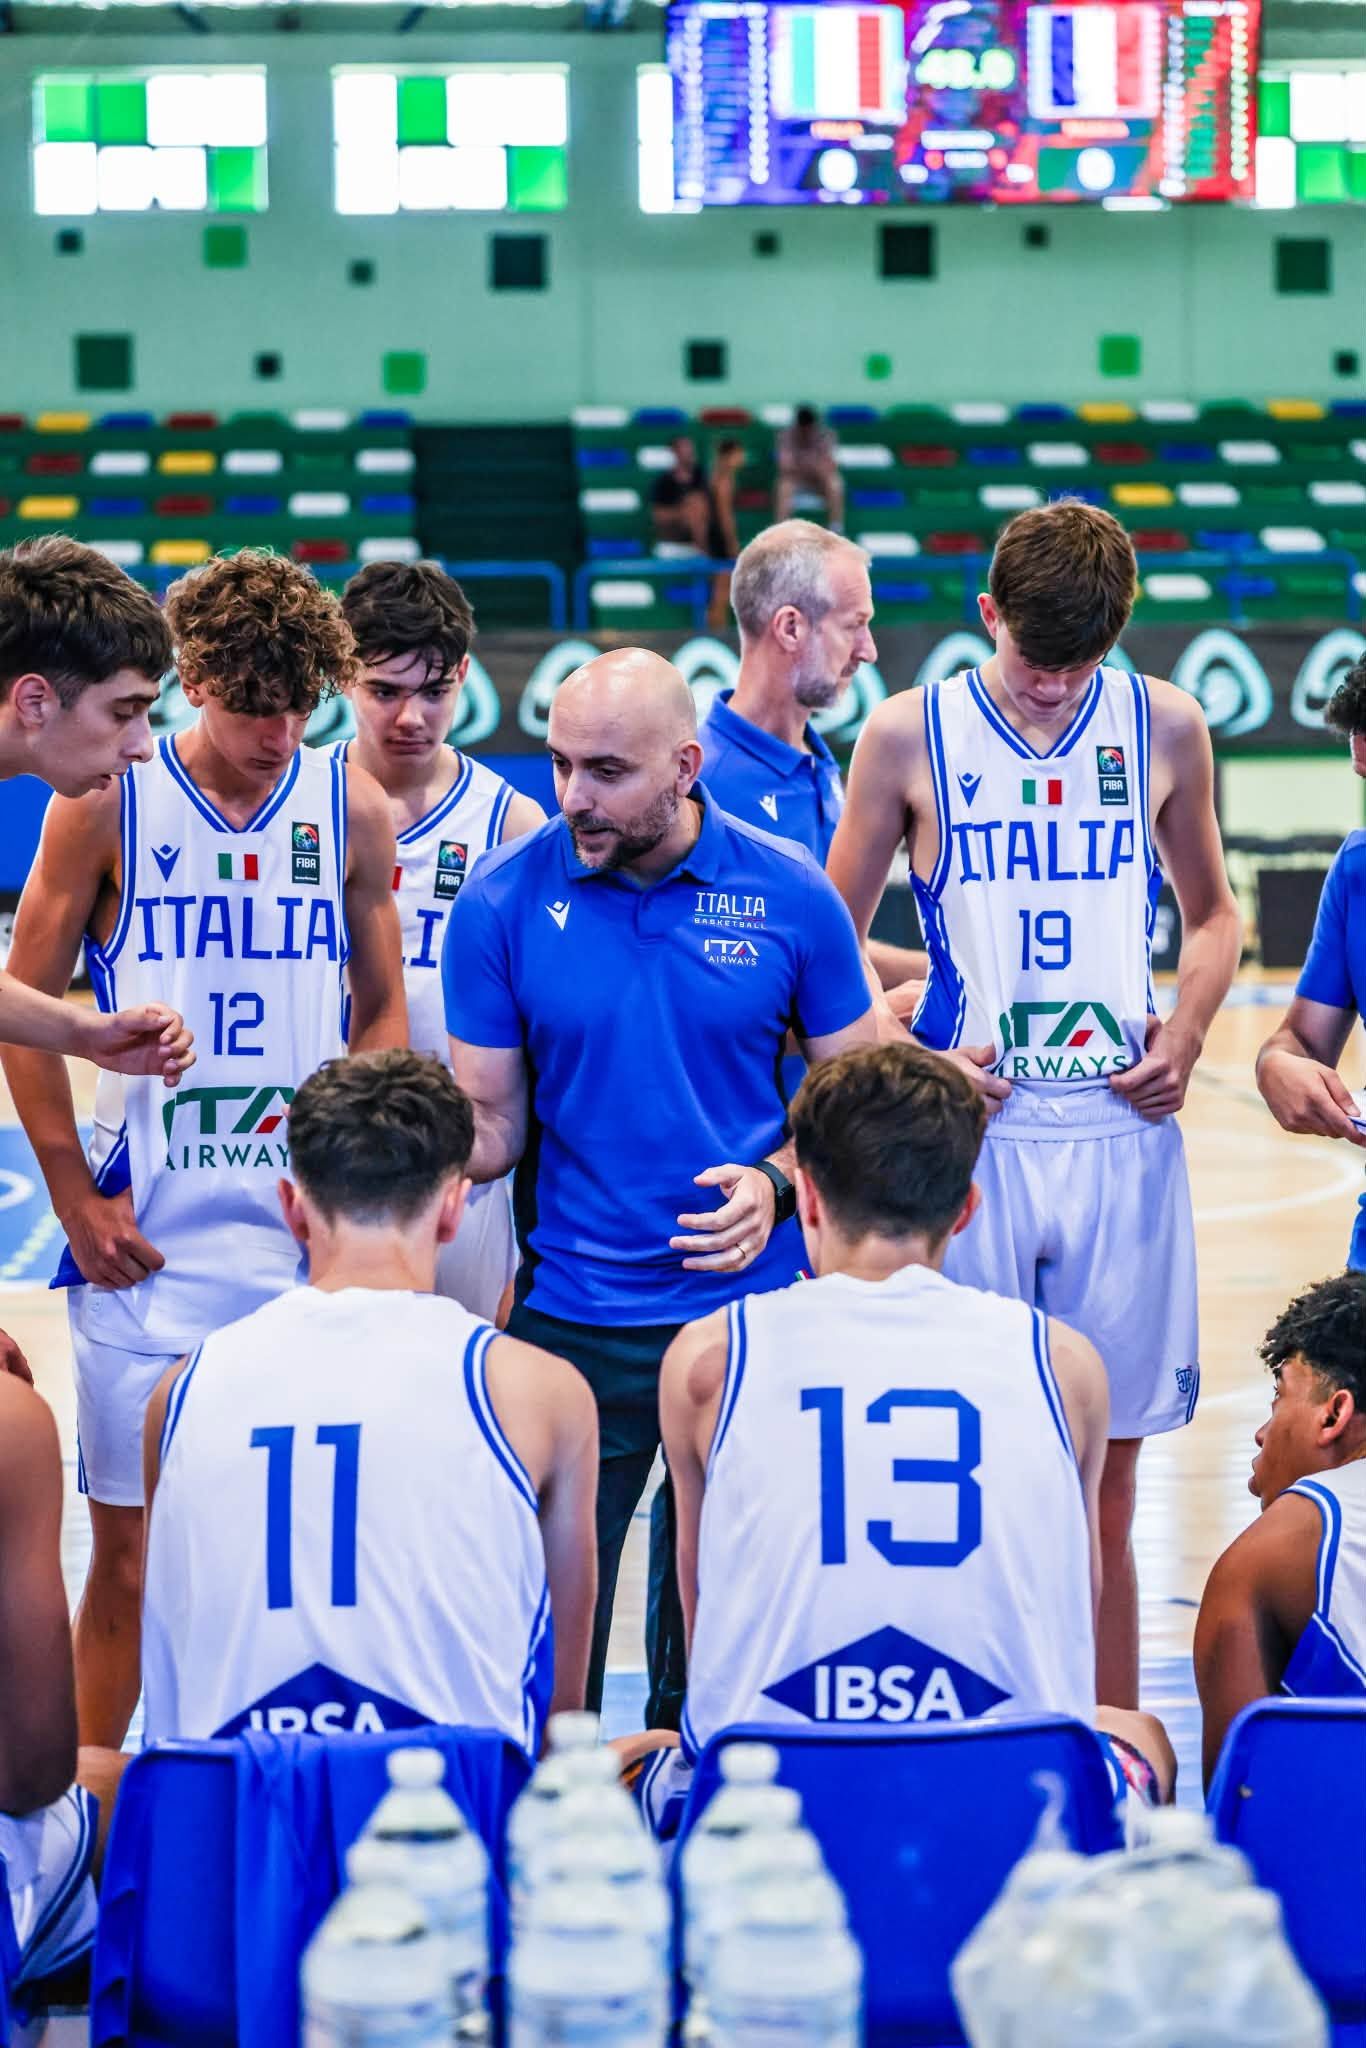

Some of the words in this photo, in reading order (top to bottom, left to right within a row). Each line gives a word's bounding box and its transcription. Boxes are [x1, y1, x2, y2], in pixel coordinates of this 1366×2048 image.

[1103, 779, 1123, 791] FIBA
[296, 857, 316, 869] FIBA
[439, 874, 461, 887] FIBA
[694, 892, 766, 917] ITALIA
[135, 895, 338, 962] ITALIA
[694, 917, 767, 930] BASKETBALL
[704, 939, 760, 956] ITA
[1019, 908, 1072, 972] 19
[708, 955, 757, 967] AIRWAYS
[209, 992, 265, 1057] 12
[166, 1144, 289, 1171] IRWAY
[800, 1387, 982, 1568] 13
[250, 1423, 362, 1611] 11
[814, 1664, 965, 1723] IBSA
